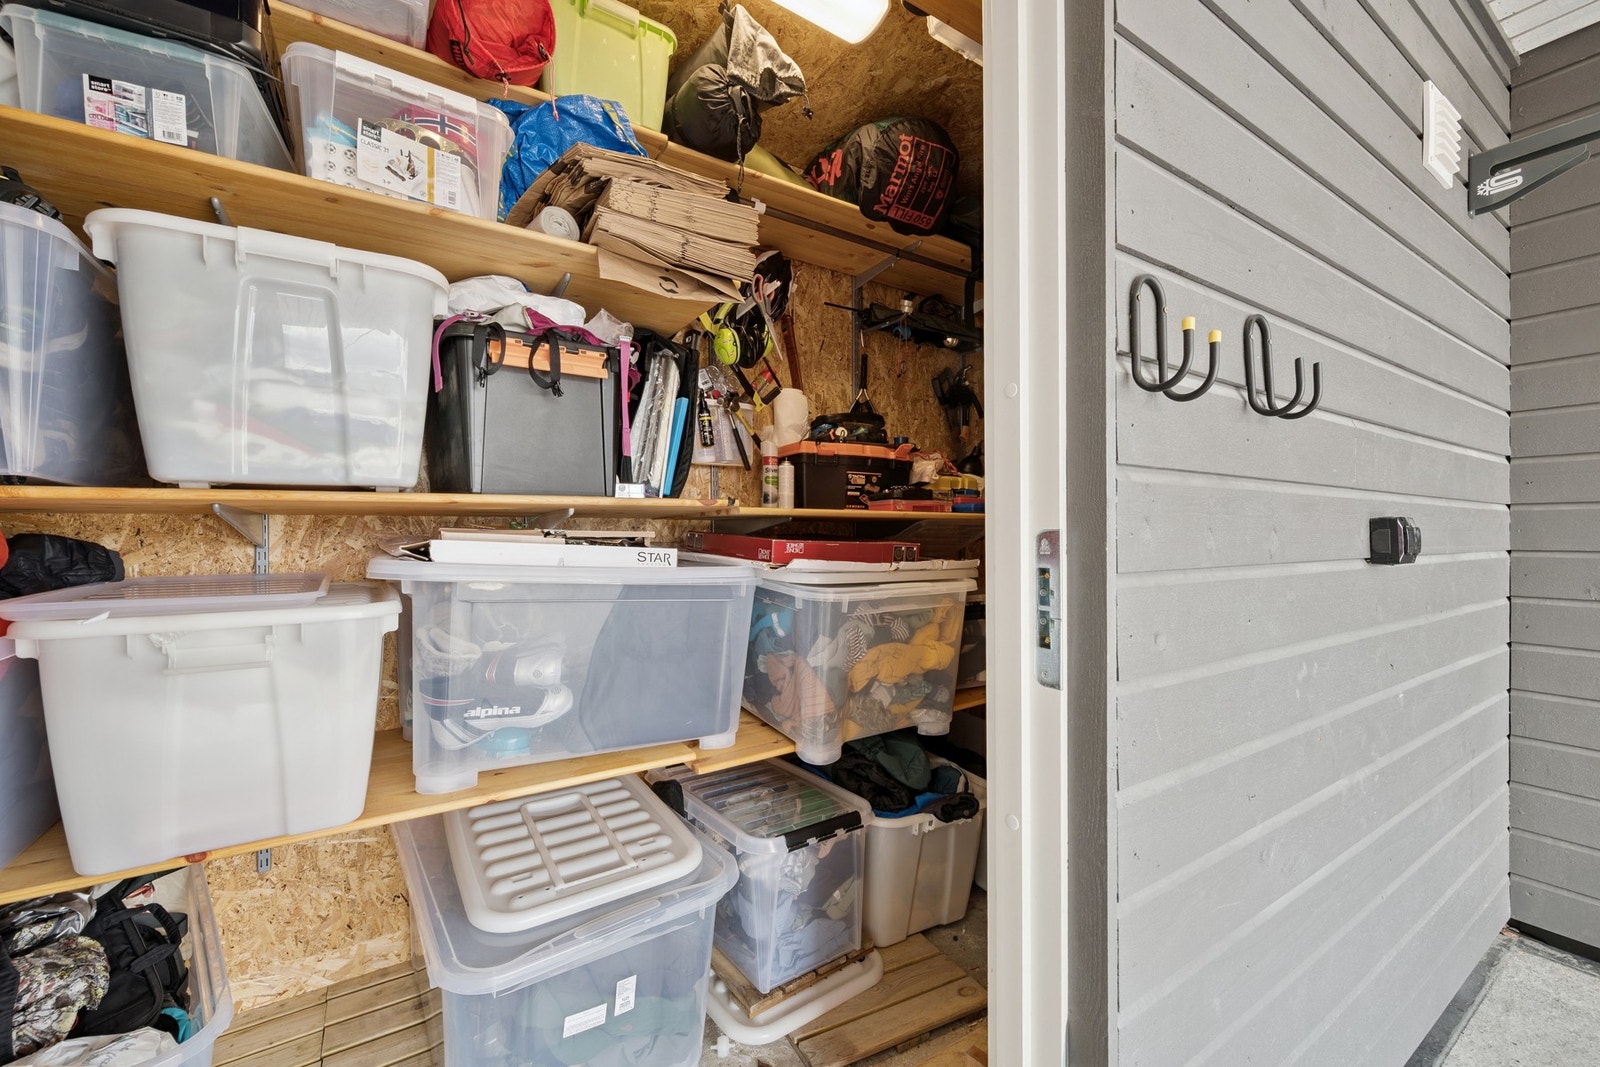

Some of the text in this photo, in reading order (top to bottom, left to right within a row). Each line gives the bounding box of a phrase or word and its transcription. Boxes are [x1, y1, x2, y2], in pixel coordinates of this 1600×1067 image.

[90, 80, 110, 89] smart
[362, 125, 381, 136] smart
[873, 133, 913, 215] Marmot
[894, 205, 933, 227] 650 FILL
[637, 551, 672, 566] STAR
[463, 705, 521, 719] alpina
